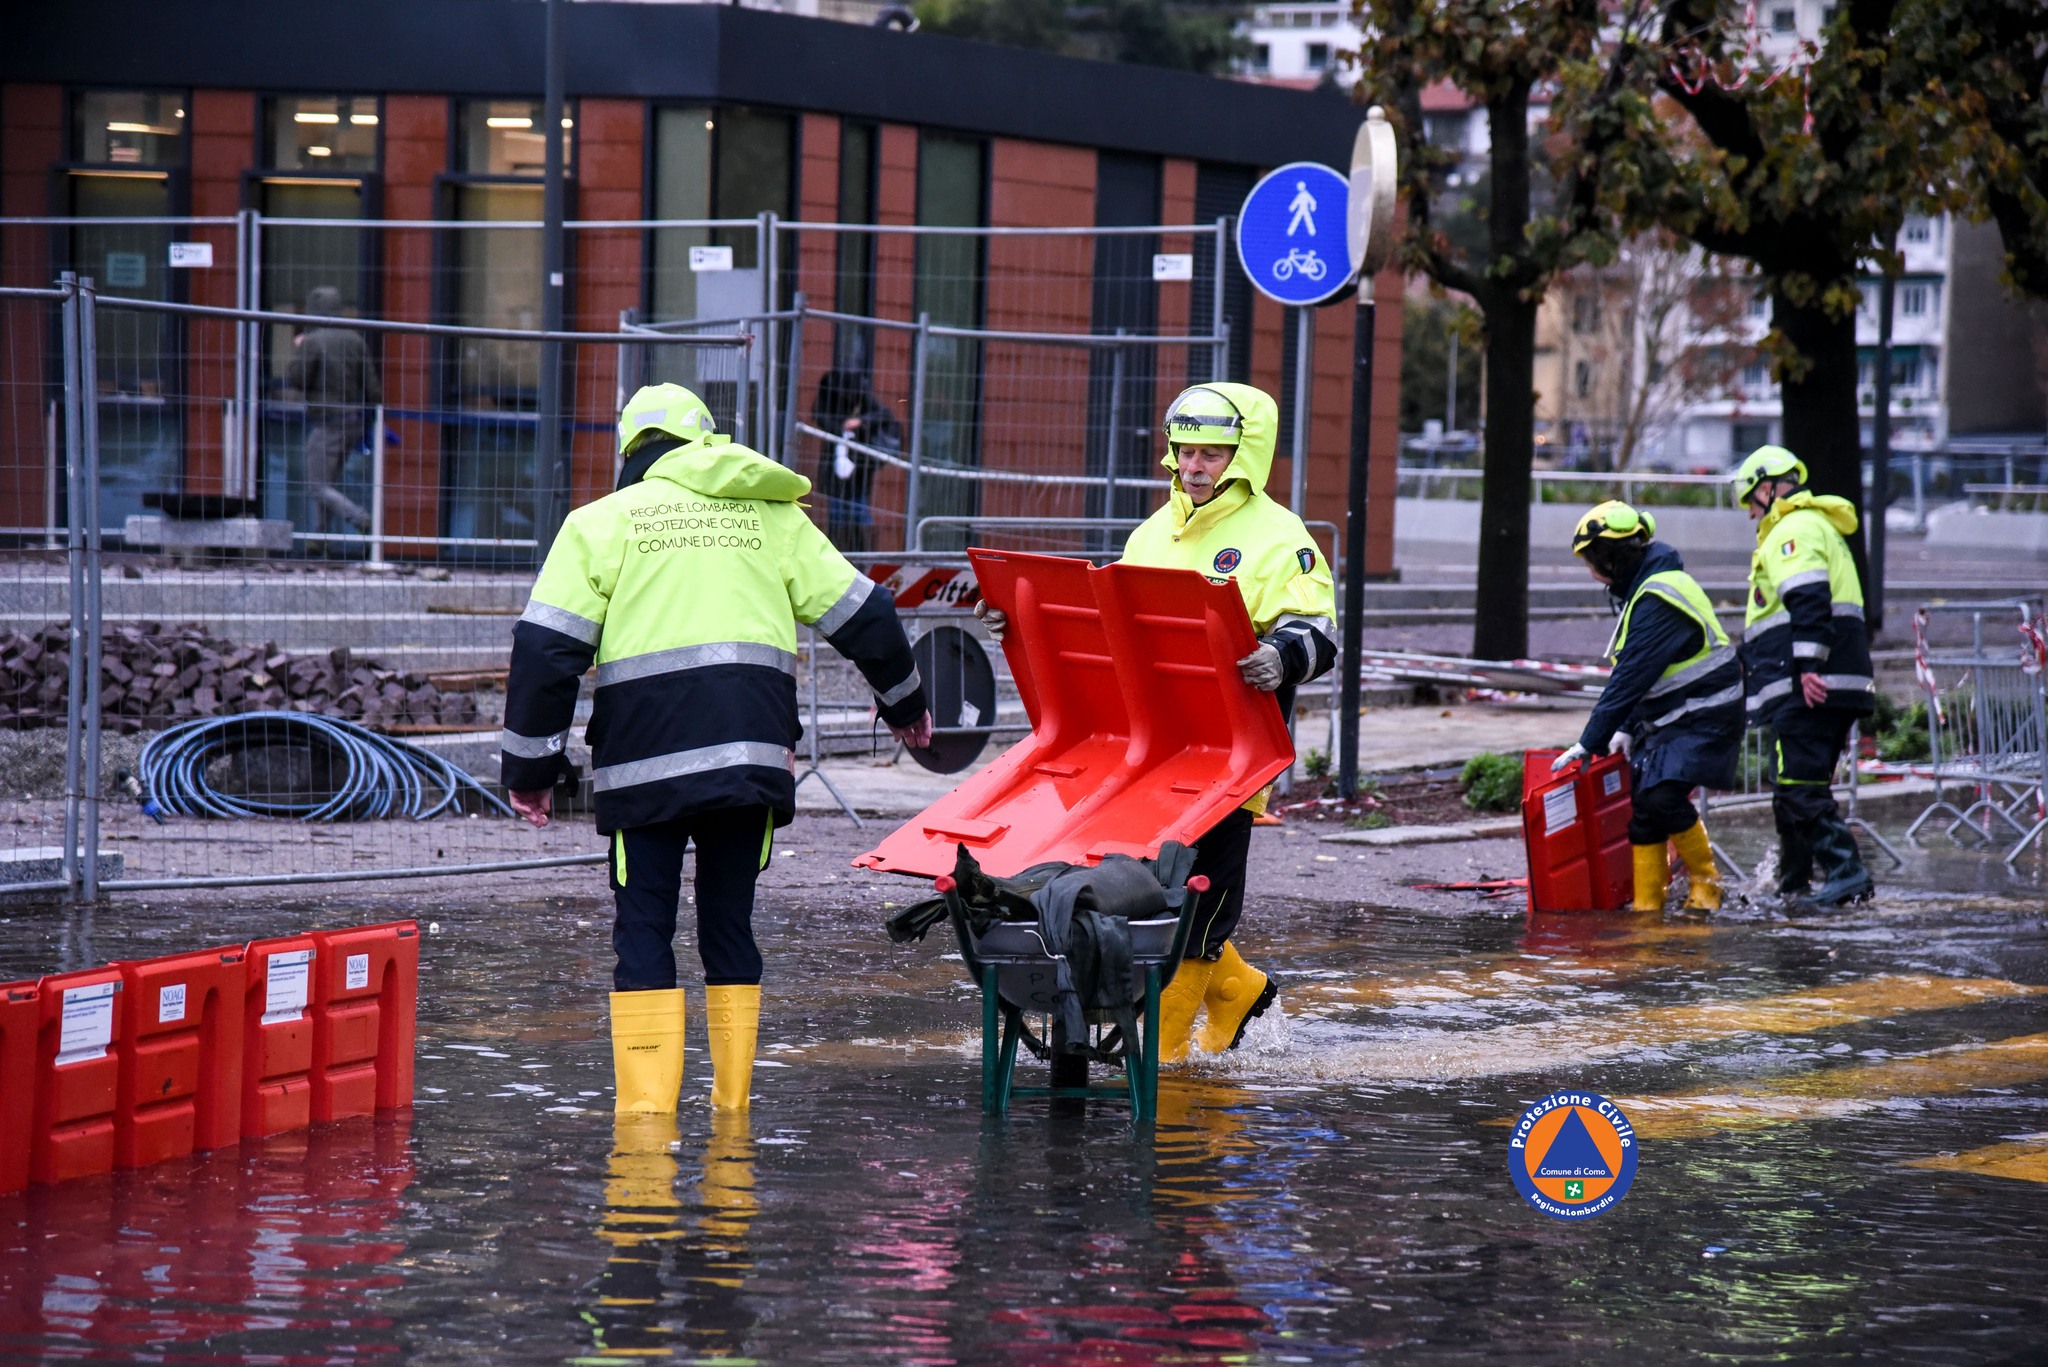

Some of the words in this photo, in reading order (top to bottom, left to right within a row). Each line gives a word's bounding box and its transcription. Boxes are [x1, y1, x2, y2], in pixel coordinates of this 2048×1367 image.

[629, 502, 686, 518] REGIONE
[686, 501, 757, 514] LOMBARDIA
[634, 518, 719, 535] PROTEZIONE
[720, 517, 760, 531] CIVILE
[638, 535, 701, 553] COMUNE
[703, 535, 716, 547] DI
[718, 535, 762, 550] COMO
